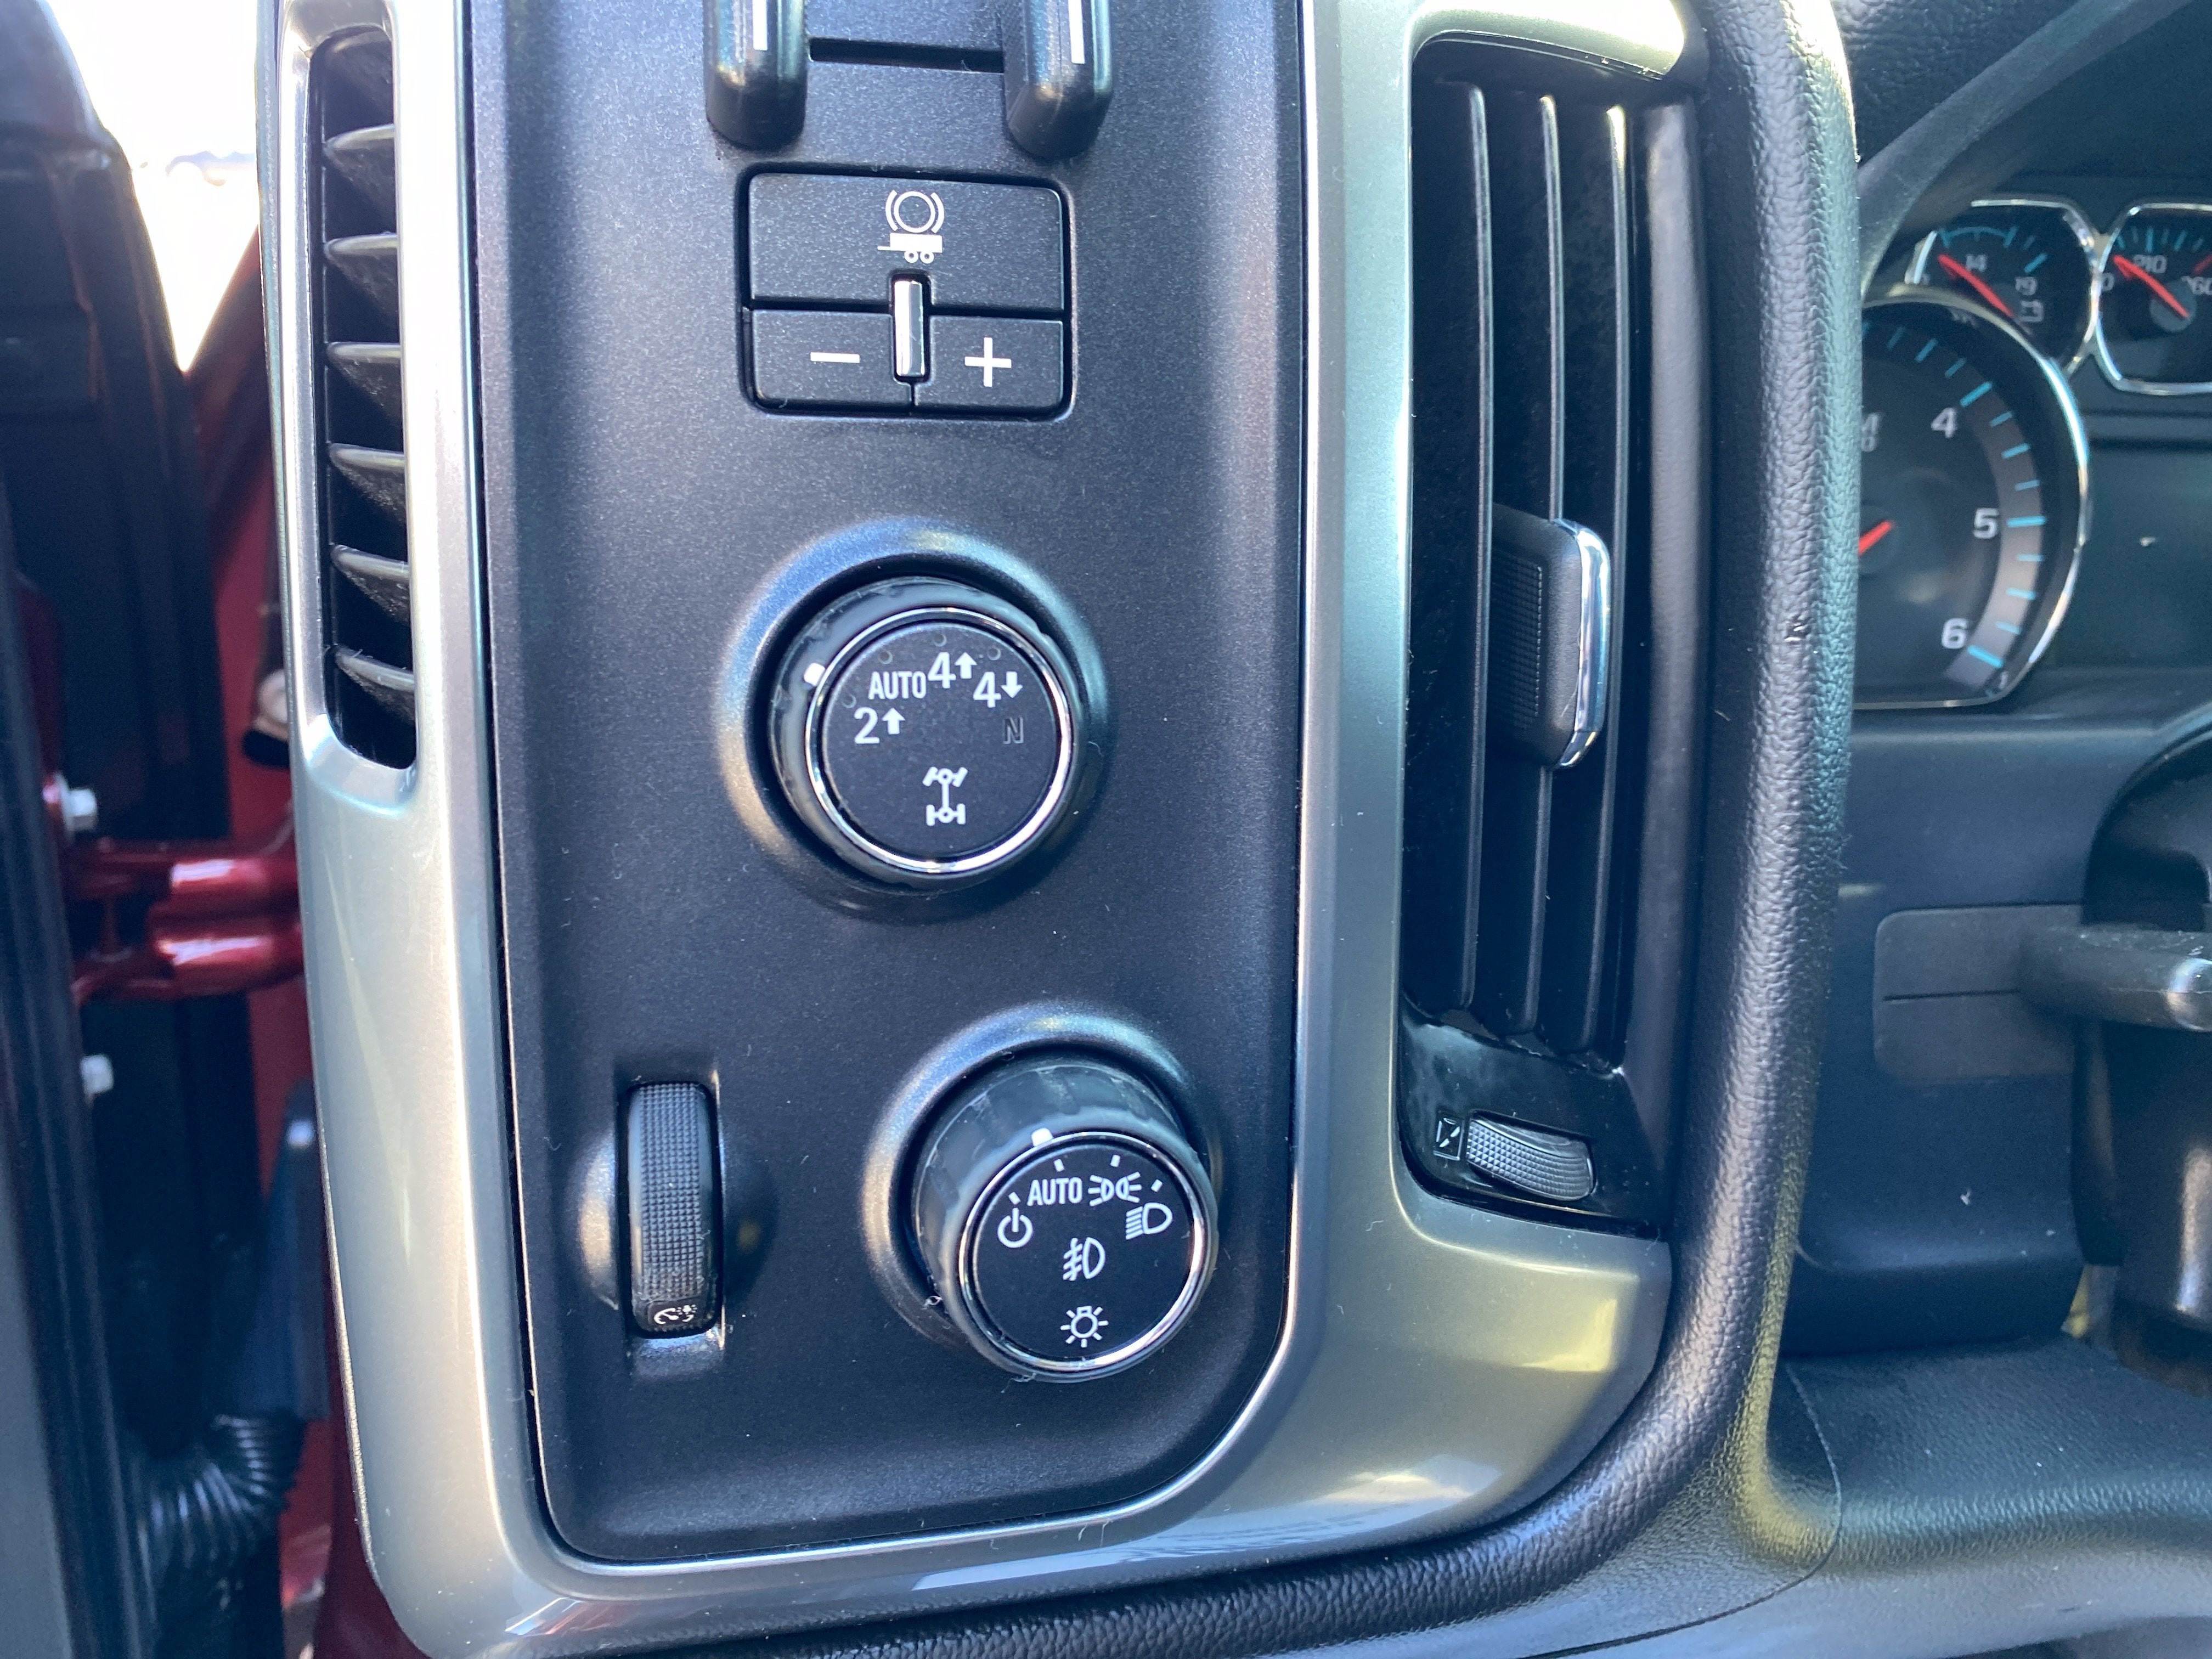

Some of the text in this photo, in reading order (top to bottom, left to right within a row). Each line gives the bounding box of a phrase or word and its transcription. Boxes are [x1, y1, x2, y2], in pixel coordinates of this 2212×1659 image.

[1931, 407, 1957, 438] 4
[1973, 507, 2000, 539] 5
[1941, 618, 1969, 649] 6
[868, 670, 927, 700] AUTO
[928, 652, 956, 689] 4
[973, 672, 1001, 708] 4
[854, 707, 880, 744] 2
[1002, 716, 1025, 744] N
[1028, 1177, 1083, 1206] AUTO
